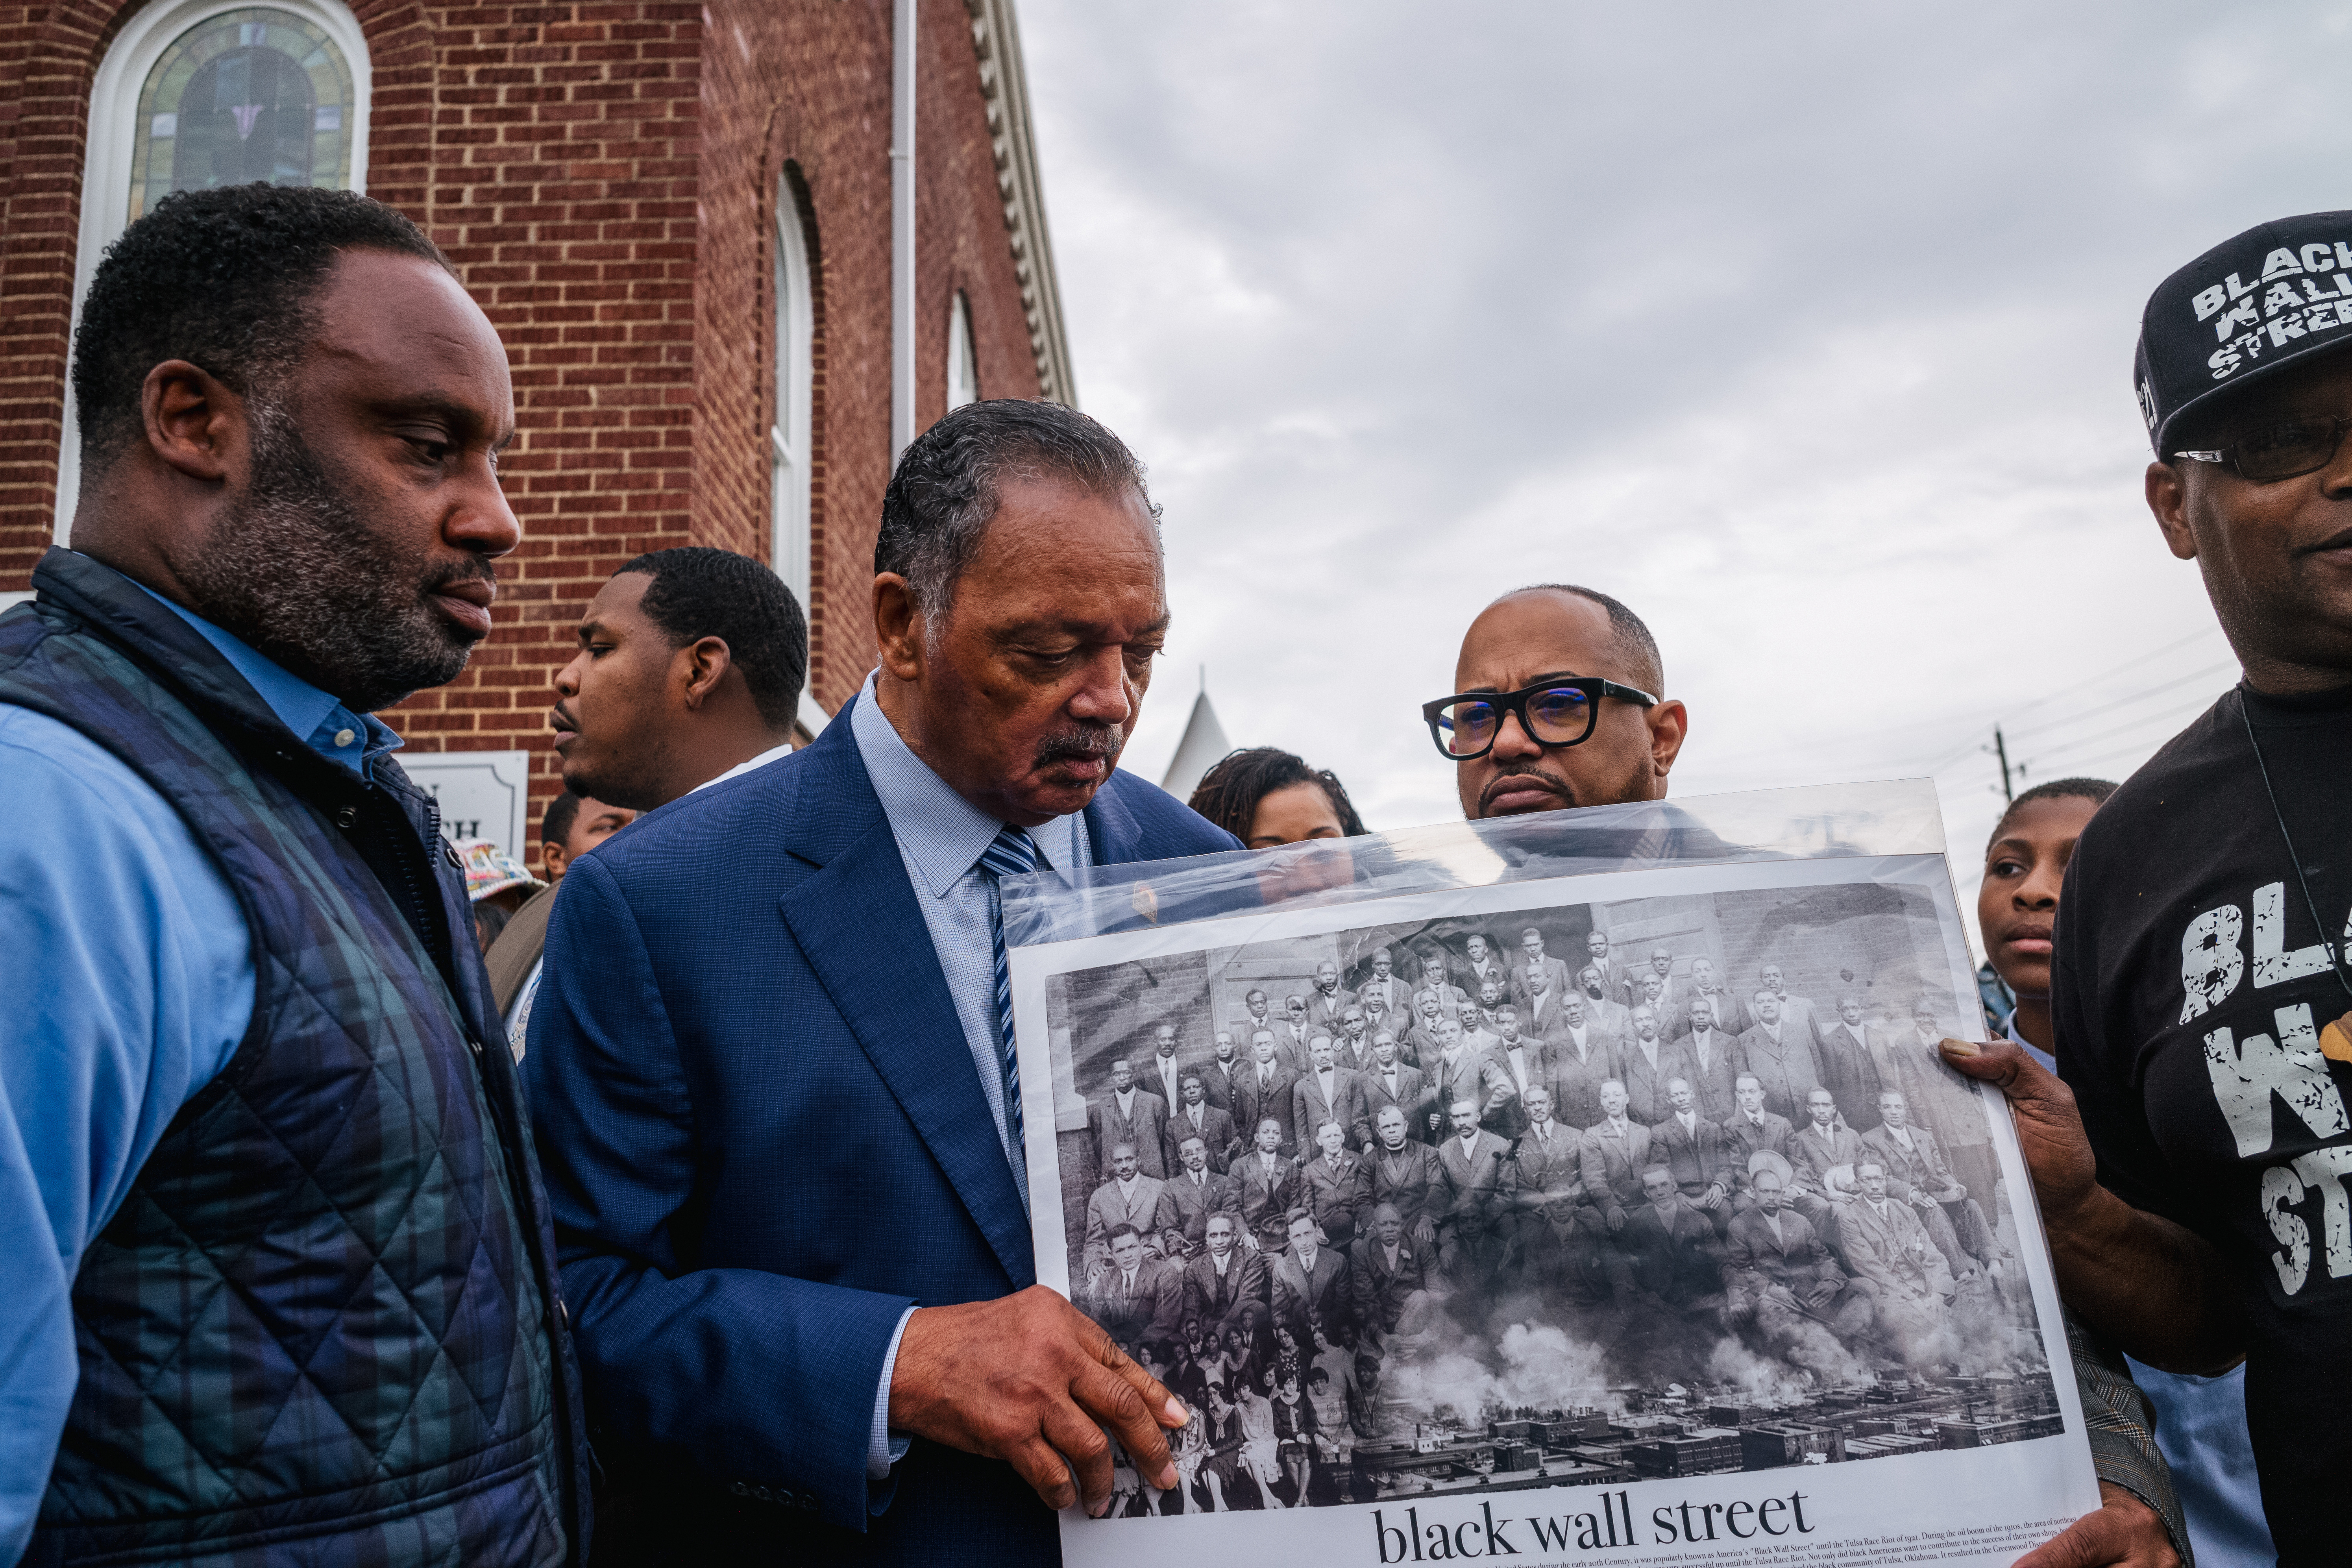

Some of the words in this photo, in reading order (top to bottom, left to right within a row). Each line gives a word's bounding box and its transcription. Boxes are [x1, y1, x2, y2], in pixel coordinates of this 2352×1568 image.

[1370, 1500, 1522, 1564] black
[1525, 1490, 1639, 1553] wall
[1652, 1490, 1816, 1545] street
[1572, 1560, 1586, 1568] early
[1605, 1558, 1633, 1566] Century,
[1653, 1553, 1683, 1564] popularly
[1716, 1548, 1749, 1558] America's
[1750, 1546, 1772, 1555] "Black
[1790, 1543, 1814, 1552] Street"
[1816, 1541, 1832, 1550] until
[1880, 1536, 1895, 1544] Riot
[1921, 1531, 1945, 1540] During
[1946, 1529, 1956, 1538] the
[1986, 1525, 1992, 1533] of
[2004, 1523, 2023, 1532] 1910s,
[2054, 1516, 2076, 1525] northeast
[1725, 1559, 1741, 1567] until
[1753, 1557, 1772, 1565] Tulsa
[1773, 1555, 1789, 1564] Race
[1790, 1554, 1807, 1562] Riot.
[1822, 1551, 1836, 1561] only
[1837, 1550, 1848, 1558] did
[1849, 1548, 1867, 1557] black
[1869, 1546, 1902, 1555] Americans
[1928, 1540, 1961, 1549] contribute
[1981, 1535, 2004, 1544] success
[2012, 1531, 2027, 1540] their
[2041, 1529, 2059, 1538] shops,
[1837, 1558, 1873, 1568] community
[1875, 1557, 1882, 1565] of
[1882, 1555, 1903, 1564] Tulsa,
[1905, 1552, 1939, 1562] Oklahoma.
[1947, 1548, 1973, 1558] resulted
[1993, 1542, 2028, 1553] Greenwood
